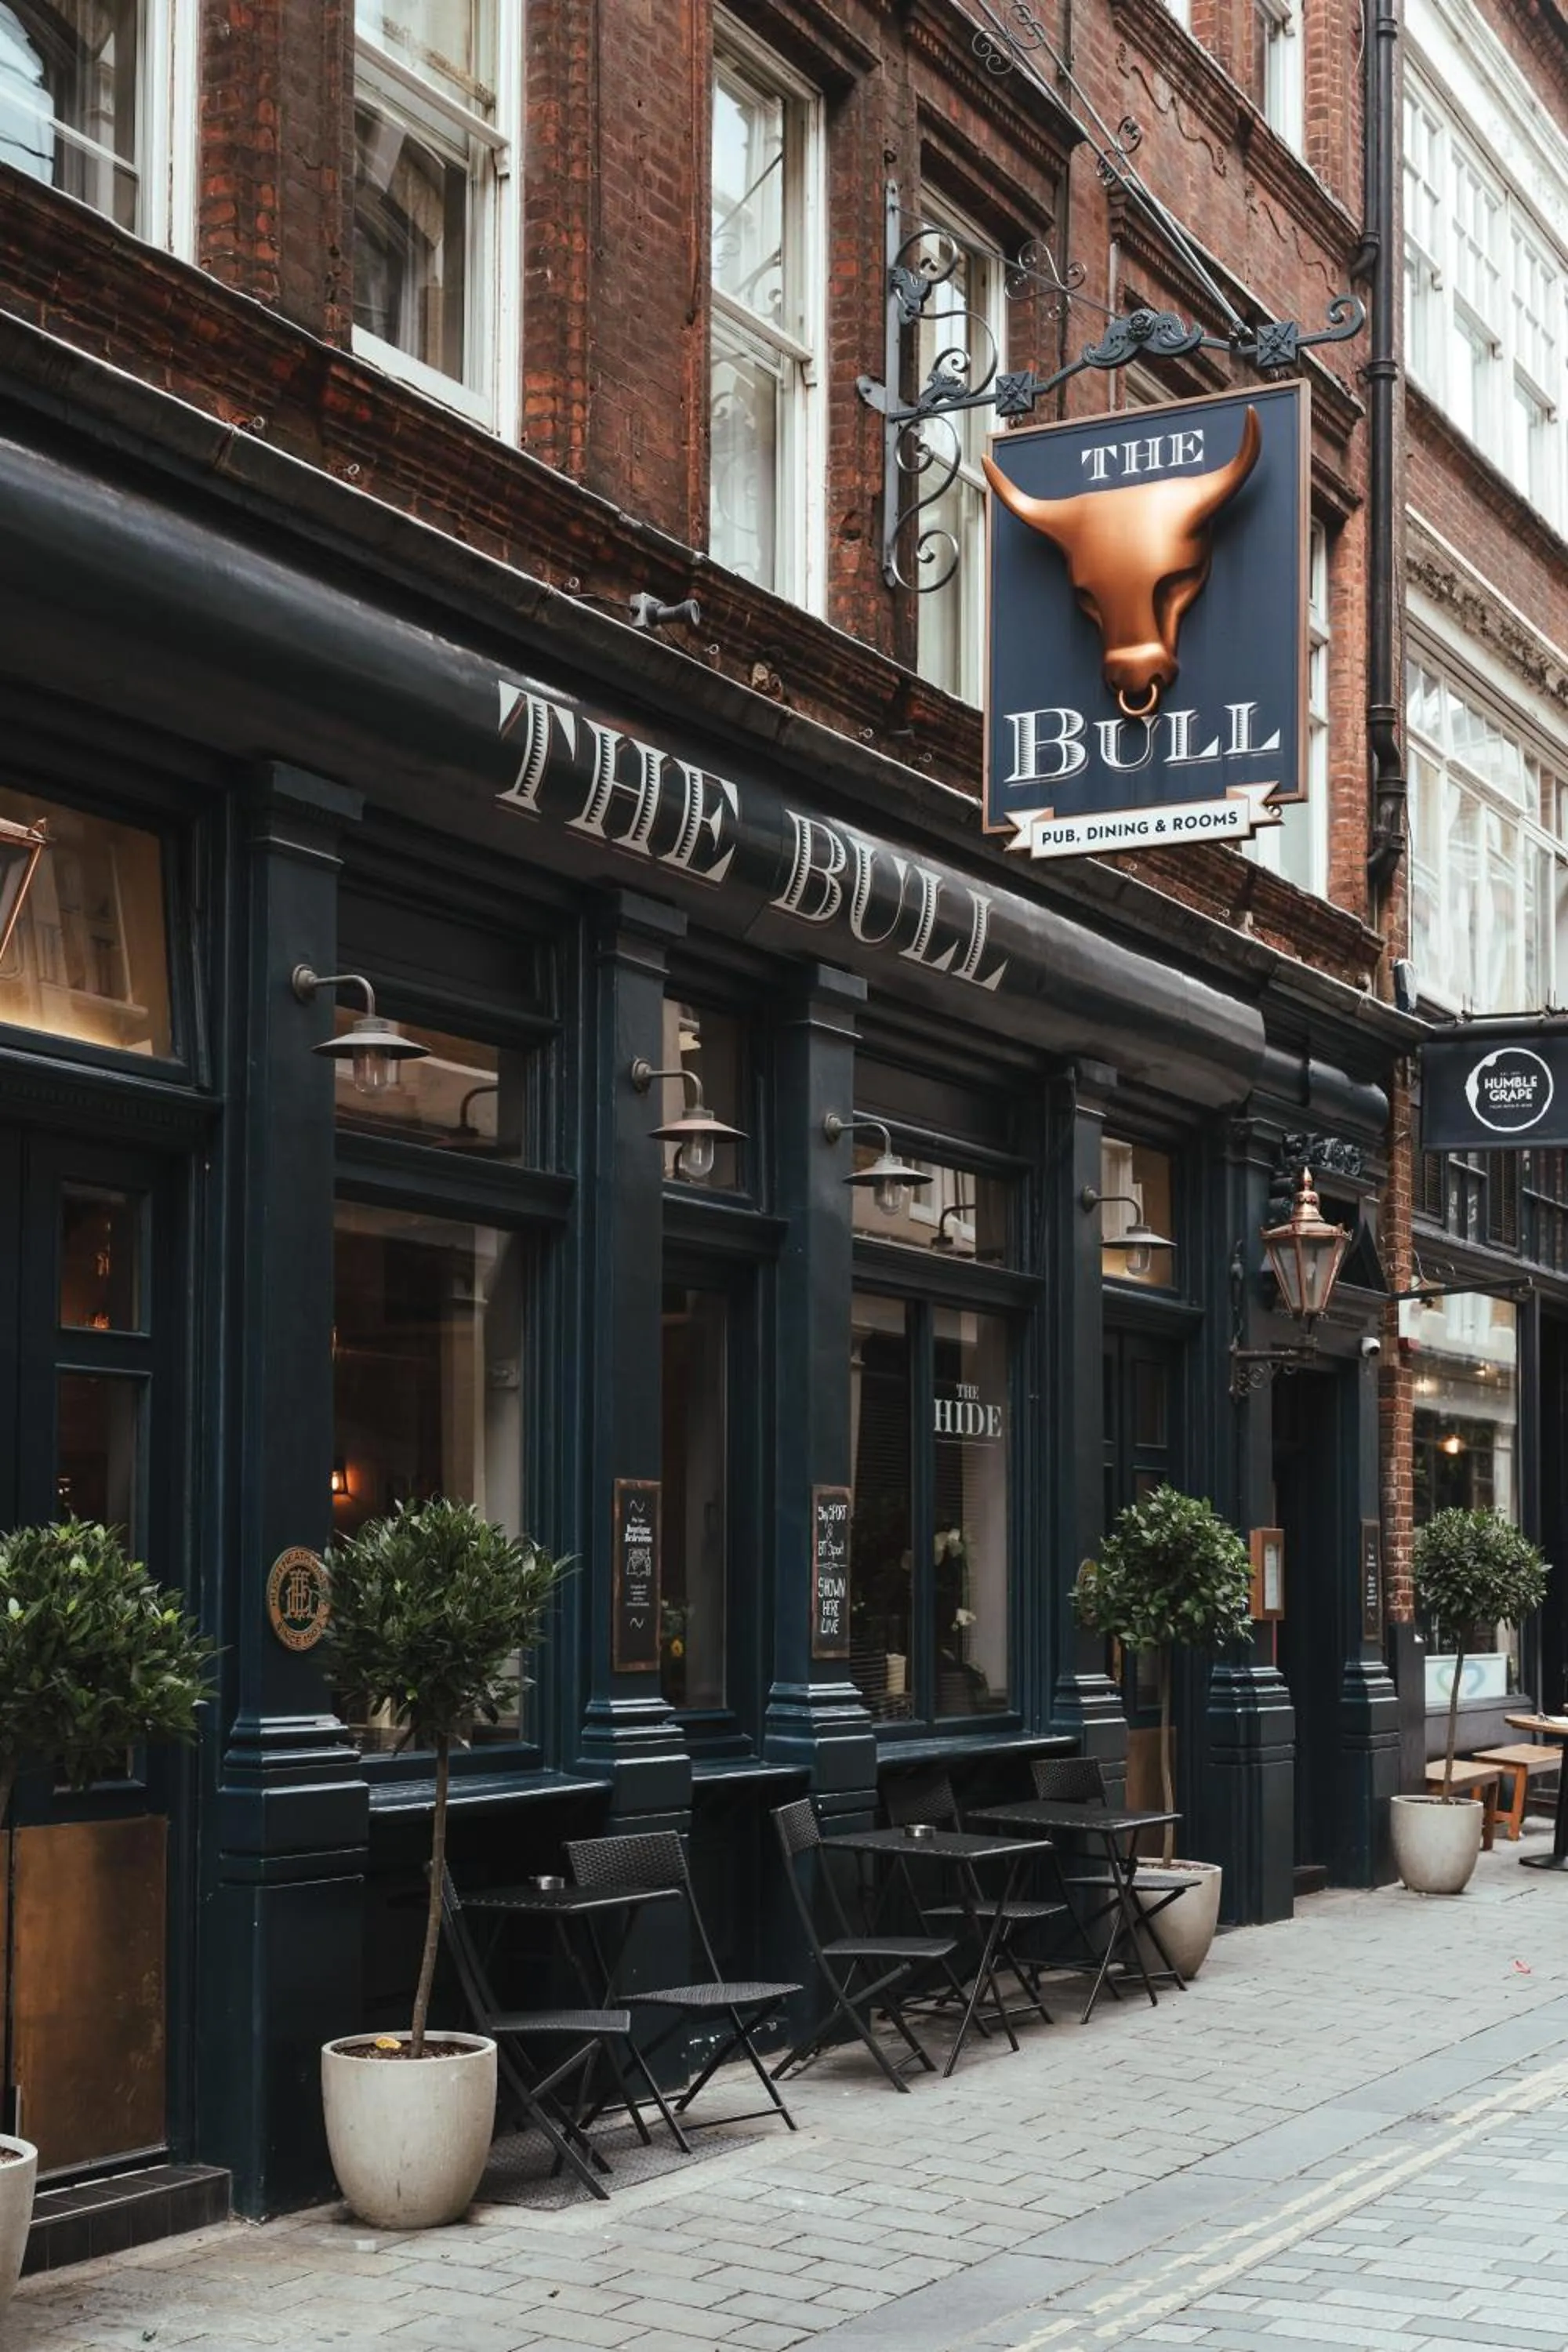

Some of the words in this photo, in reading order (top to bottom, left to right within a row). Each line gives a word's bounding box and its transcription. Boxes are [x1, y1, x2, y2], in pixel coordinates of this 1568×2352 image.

[1081, 430, 1204, 481] THE
[1004, 702, 1281, 786] BULL
[495, 680, 739, 886] THE
[770, 809, 1010, 993] BULL
[1042, 829, 1080, 844] PUB,
[1087, 821, 1149, 840] DINING
[1155, 819, 1166, 832] &
[1173, 811, 1238, 830] ROOMS
[1484, 1076, 1537, 1090] HUMBLE
[1490, 1088, 1533, 1102] GRAPE
[956, 1384, 979, 1399] THE
[935, 1399, 1001, 1437] HIDE
[818, 1577, 846, 1598] SHOWN
[822, 1600, 840, 1617] HERE
[821, 1617, 840, 1635] LIVE
